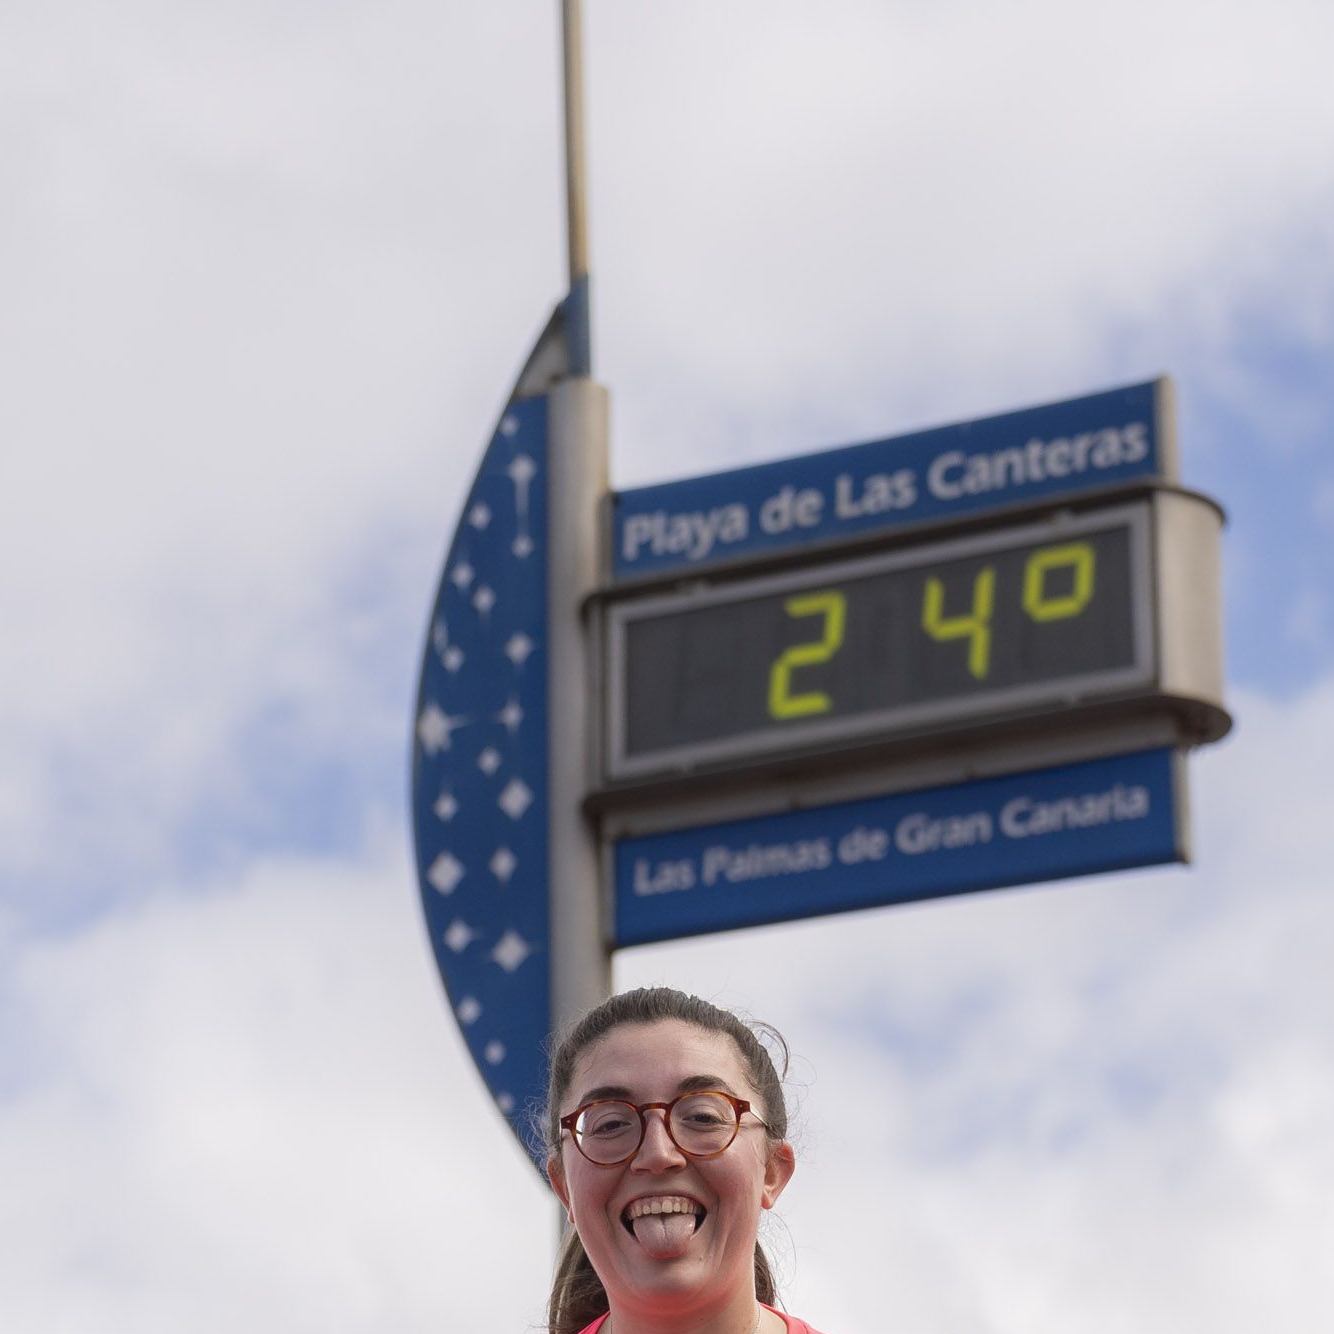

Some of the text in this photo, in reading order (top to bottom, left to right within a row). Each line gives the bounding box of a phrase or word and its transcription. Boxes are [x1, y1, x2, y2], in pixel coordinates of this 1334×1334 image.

[623, 422, 1149, 561] Playa de Las Canteras
[633, 782, 1149, 897] Las Palmas de Gran Canaria
